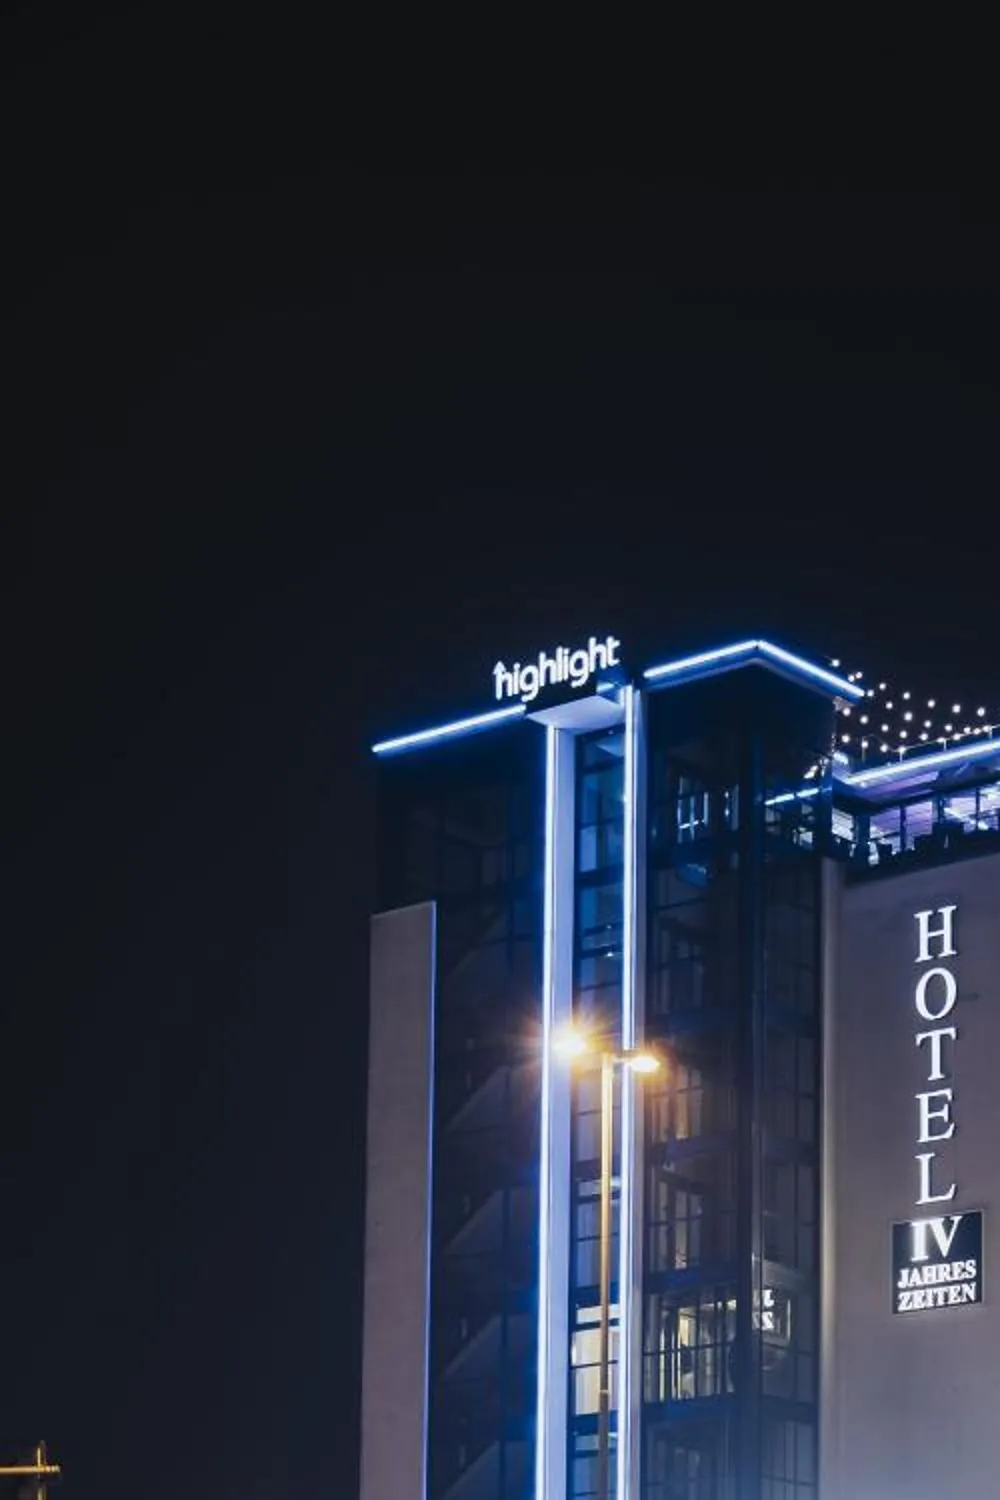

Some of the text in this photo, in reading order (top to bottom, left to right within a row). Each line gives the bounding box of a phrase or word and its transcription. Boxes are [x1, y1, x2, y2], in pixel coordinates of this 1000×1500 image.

[493, 636, 620, 702] highlight
[913, 905, 958, 1205] HOTEL
[910, 1215, 962, 1262] IV
[897, 1259, 976, 1289] JAHRES
[897, 1282, 976, 1311] ZEITEN
